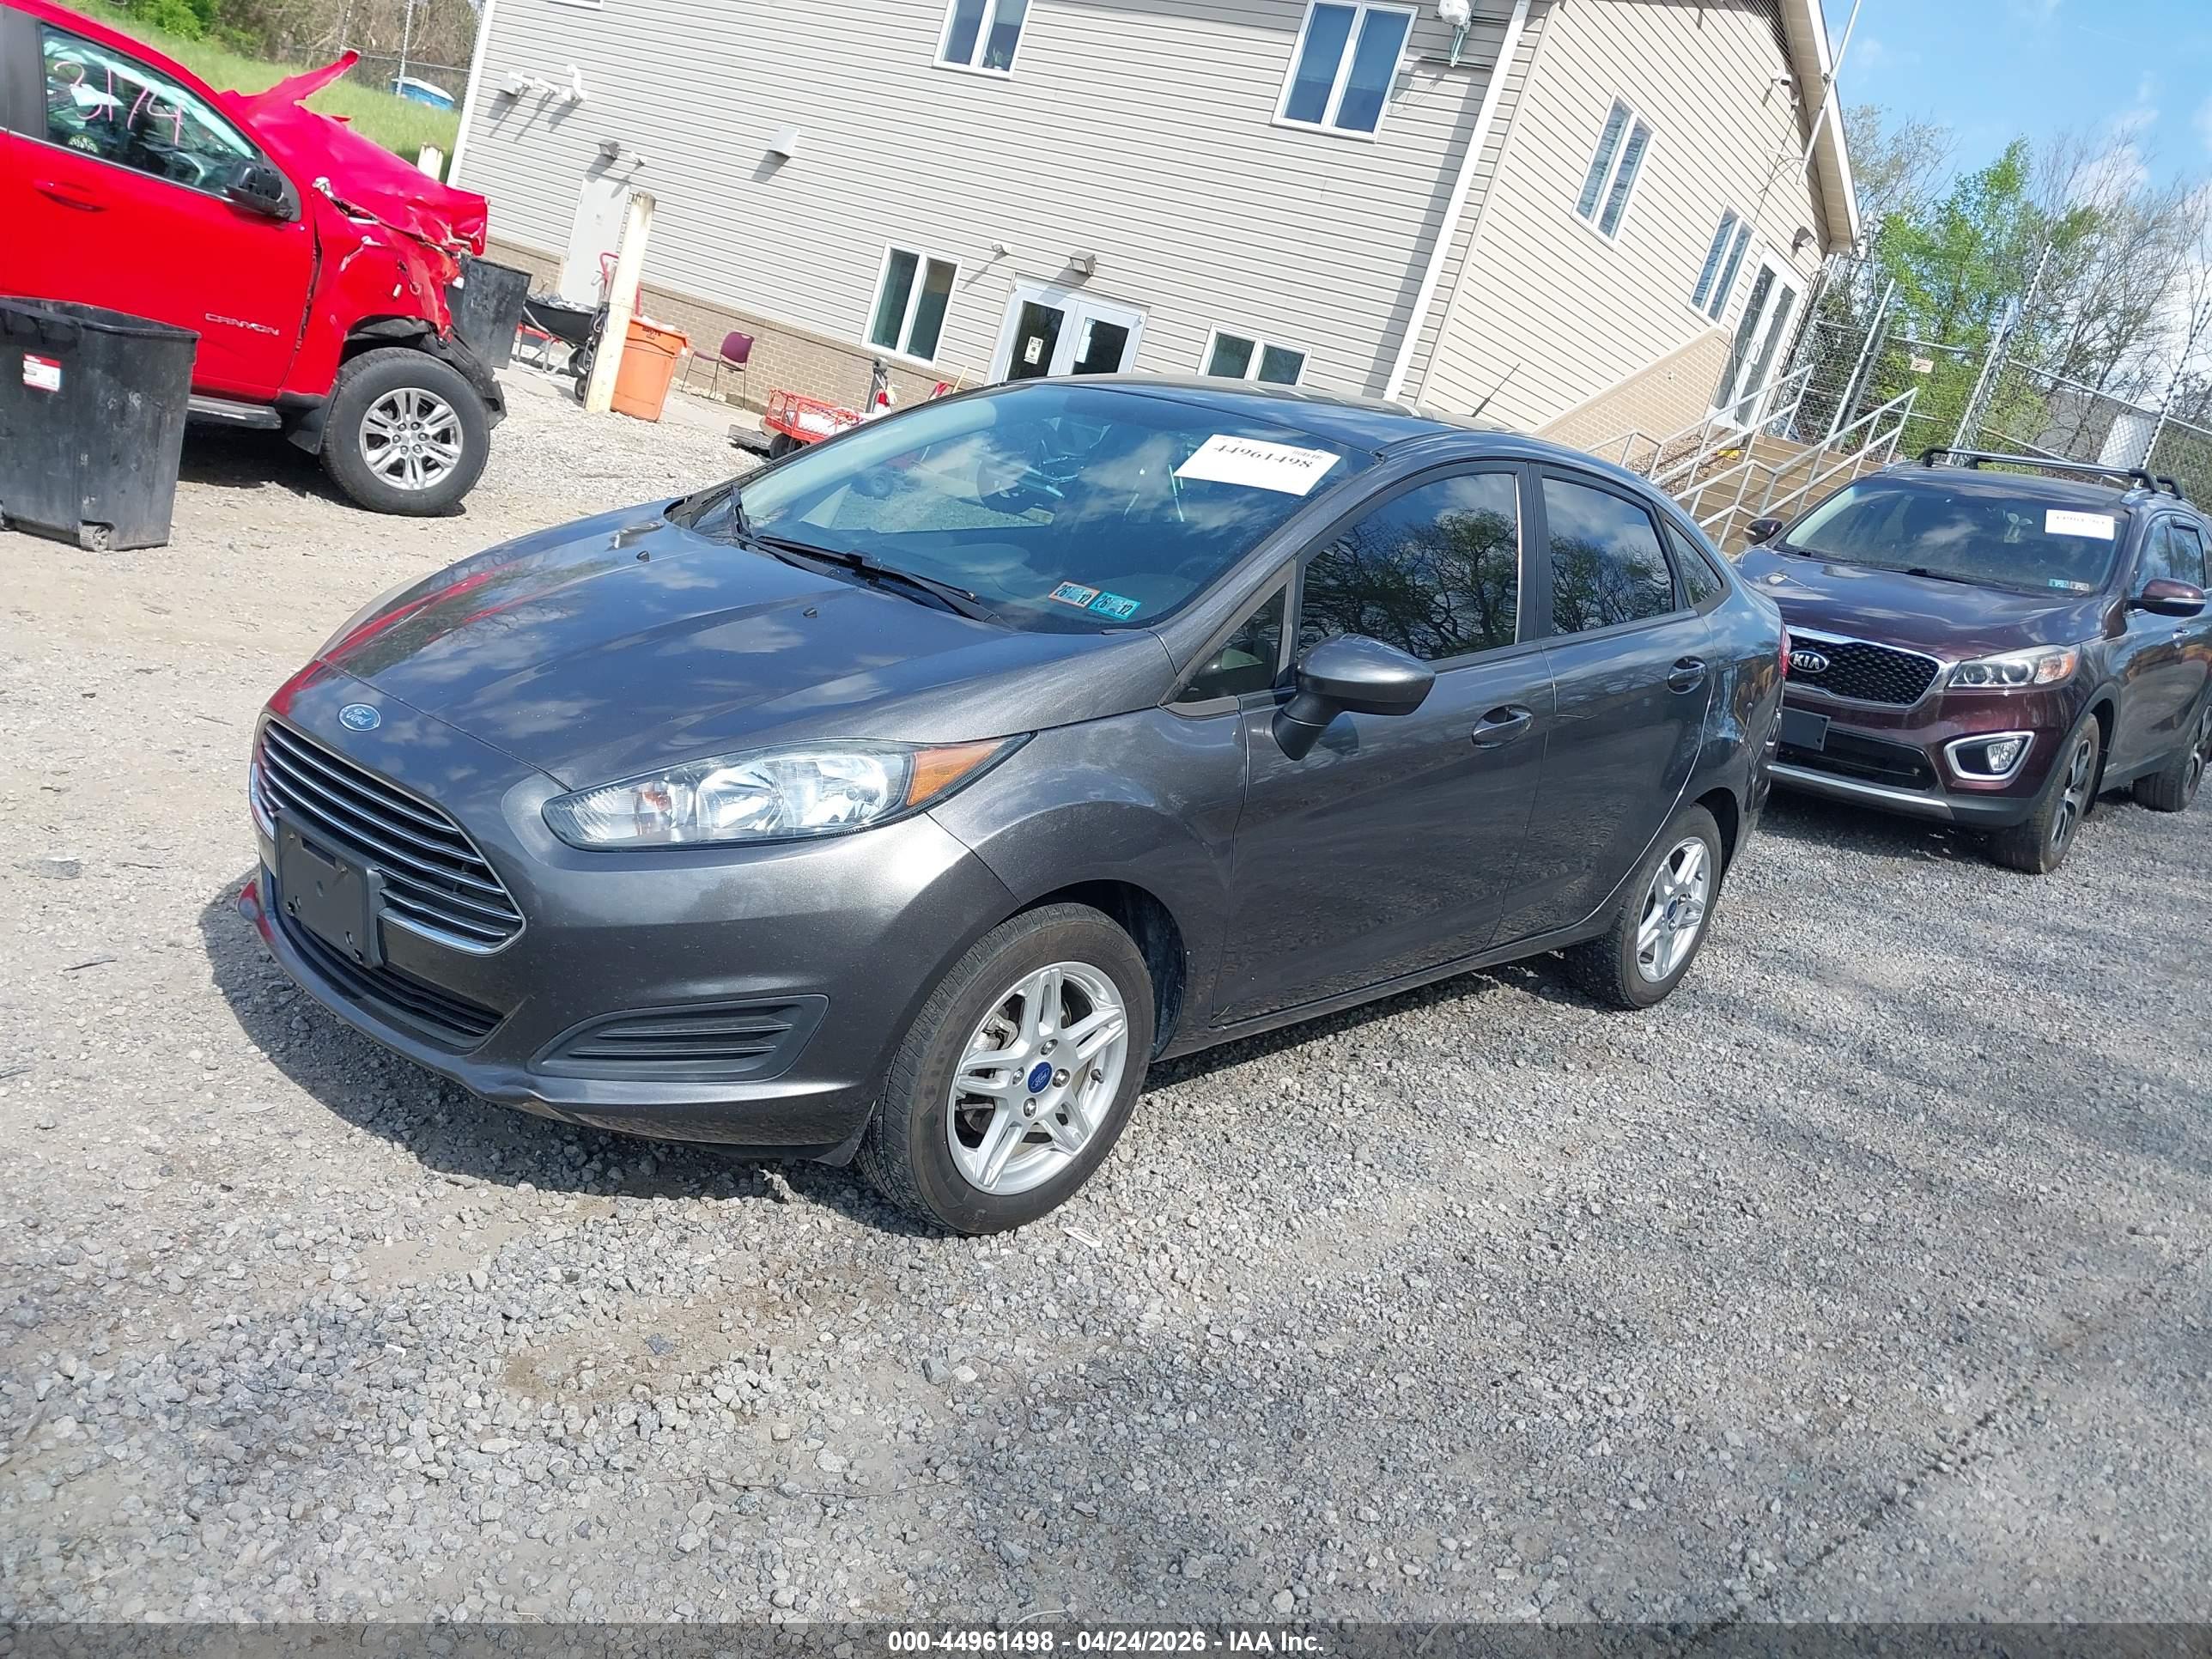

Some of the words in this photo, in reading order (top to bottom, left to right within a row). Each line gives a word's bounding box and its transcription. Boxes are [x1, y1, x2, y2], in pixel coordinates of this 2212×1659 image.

[204, 313, 280, 336] CANYON
[1212, 444, 1314, 469] 44961498
[1078, 593, 1092, 605] 12
[1116, 604, 1133, 615] 12
[1792, 653, 1820, 670] KIA
[345, 708, 372, 726] Ford
